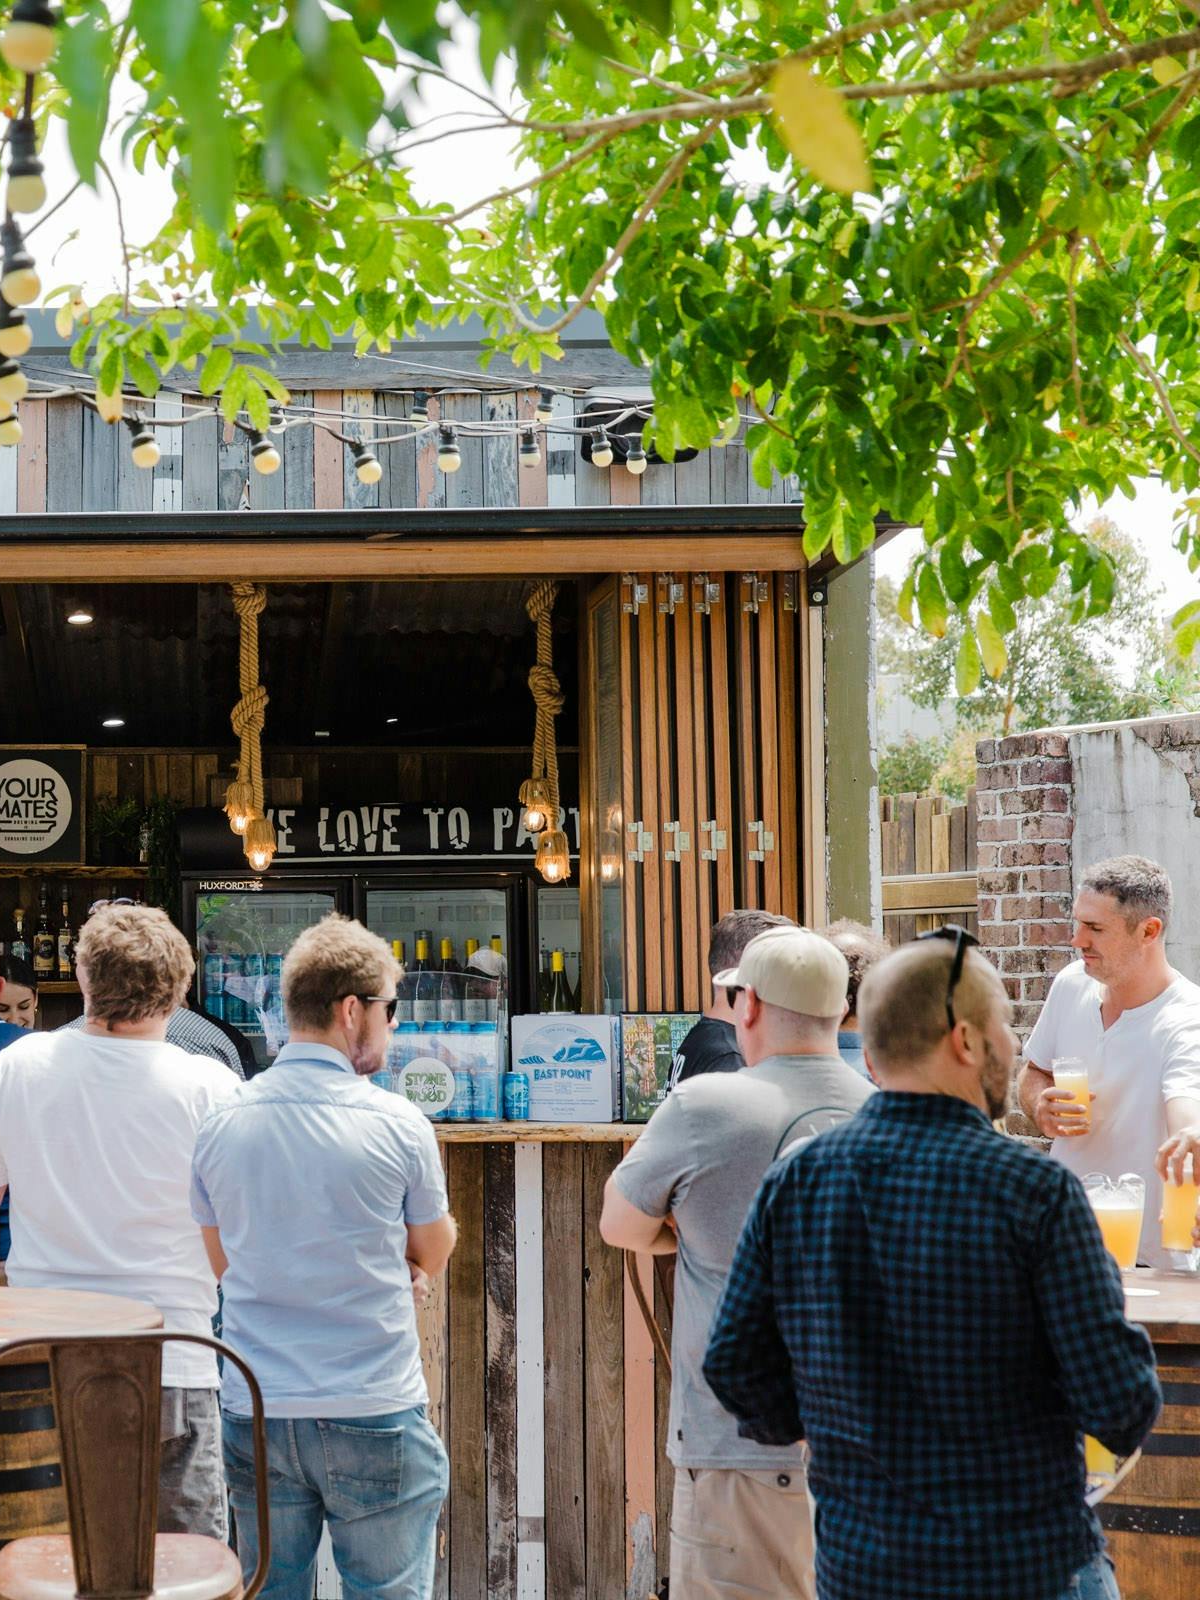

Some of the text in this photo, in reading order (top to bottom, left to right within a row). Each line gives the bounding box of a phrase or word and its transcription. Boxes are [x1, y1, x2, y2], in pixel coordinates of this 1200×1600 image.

[318, 806, 400, 852] LOVE
[423, 807, 470, 849] TO
[405, 1072, 447, 1086] STONE
[533, 1069, 592, 1081] EAST POINT
[405, 1089, 447, 1102] WOOD
